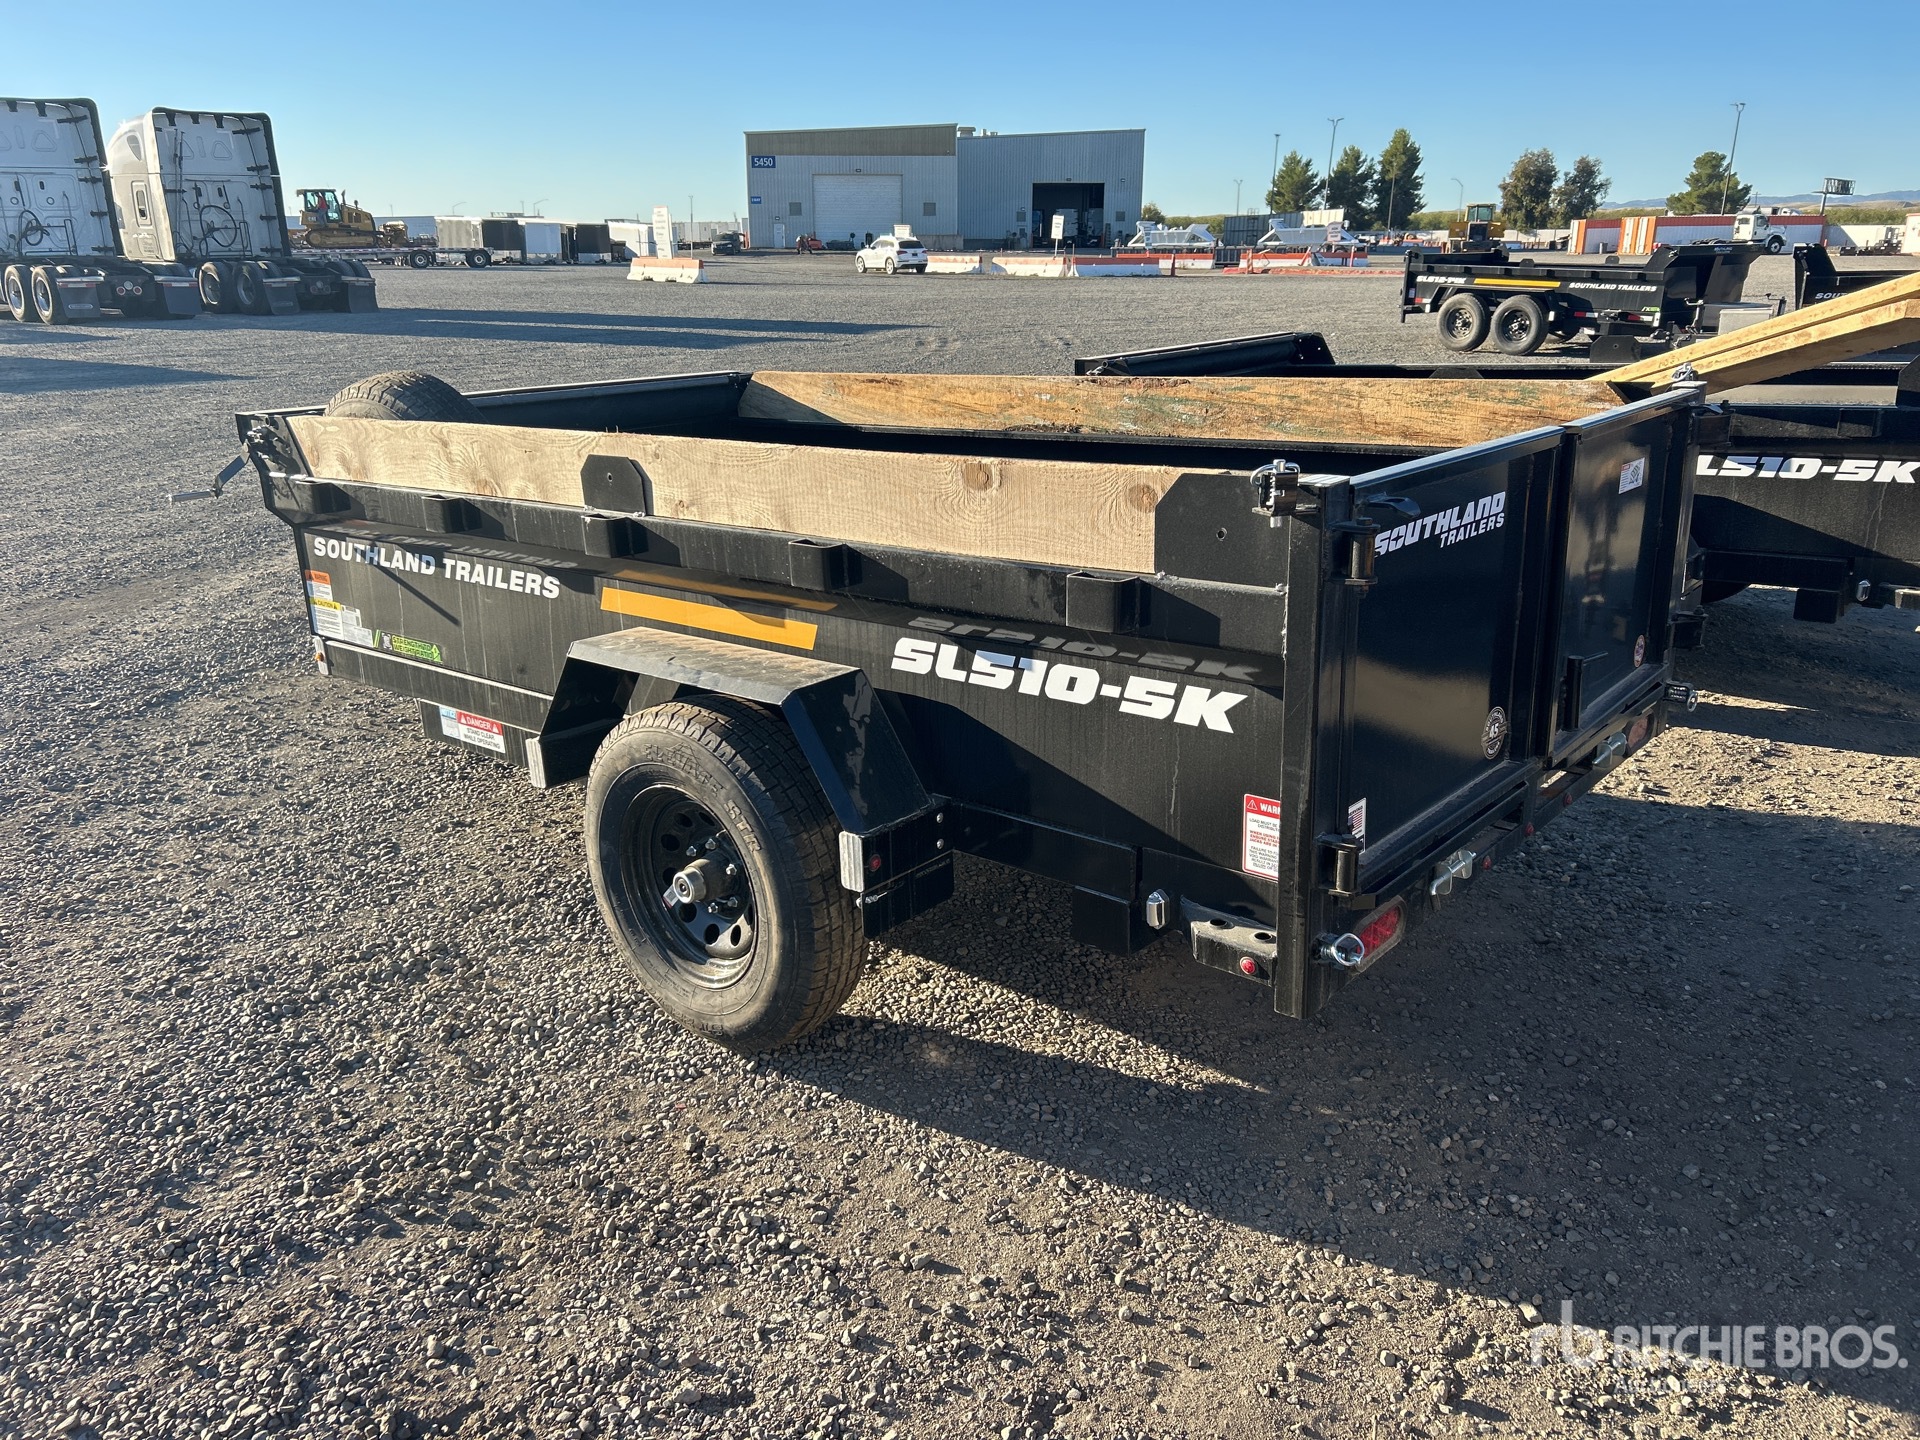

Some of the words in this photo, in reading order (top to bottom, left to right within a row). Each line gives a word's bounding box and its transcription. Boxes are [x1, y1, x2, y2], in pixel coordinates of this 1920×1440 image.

[754, 157, 774, 167] 5450
[1569, 282, 1617, 290] SOUTHLAND
[1617, 284, 1658, 292] TRAILERS
[1696, 454, 1920, 484] L510-5K
[1374, 491, 1506, 557] SOUTHLAND
[1440, 512, 1505, 549] TRAILERS
[313, 537, 436, 576] SOUTHLAND
[442, 557, 561, 599] TRAILERS
[317, 600, 333, 608] CAUTION
[891, 637, 1249, 734] SL510-5K
[466, 716, 492, 730] DANGER
